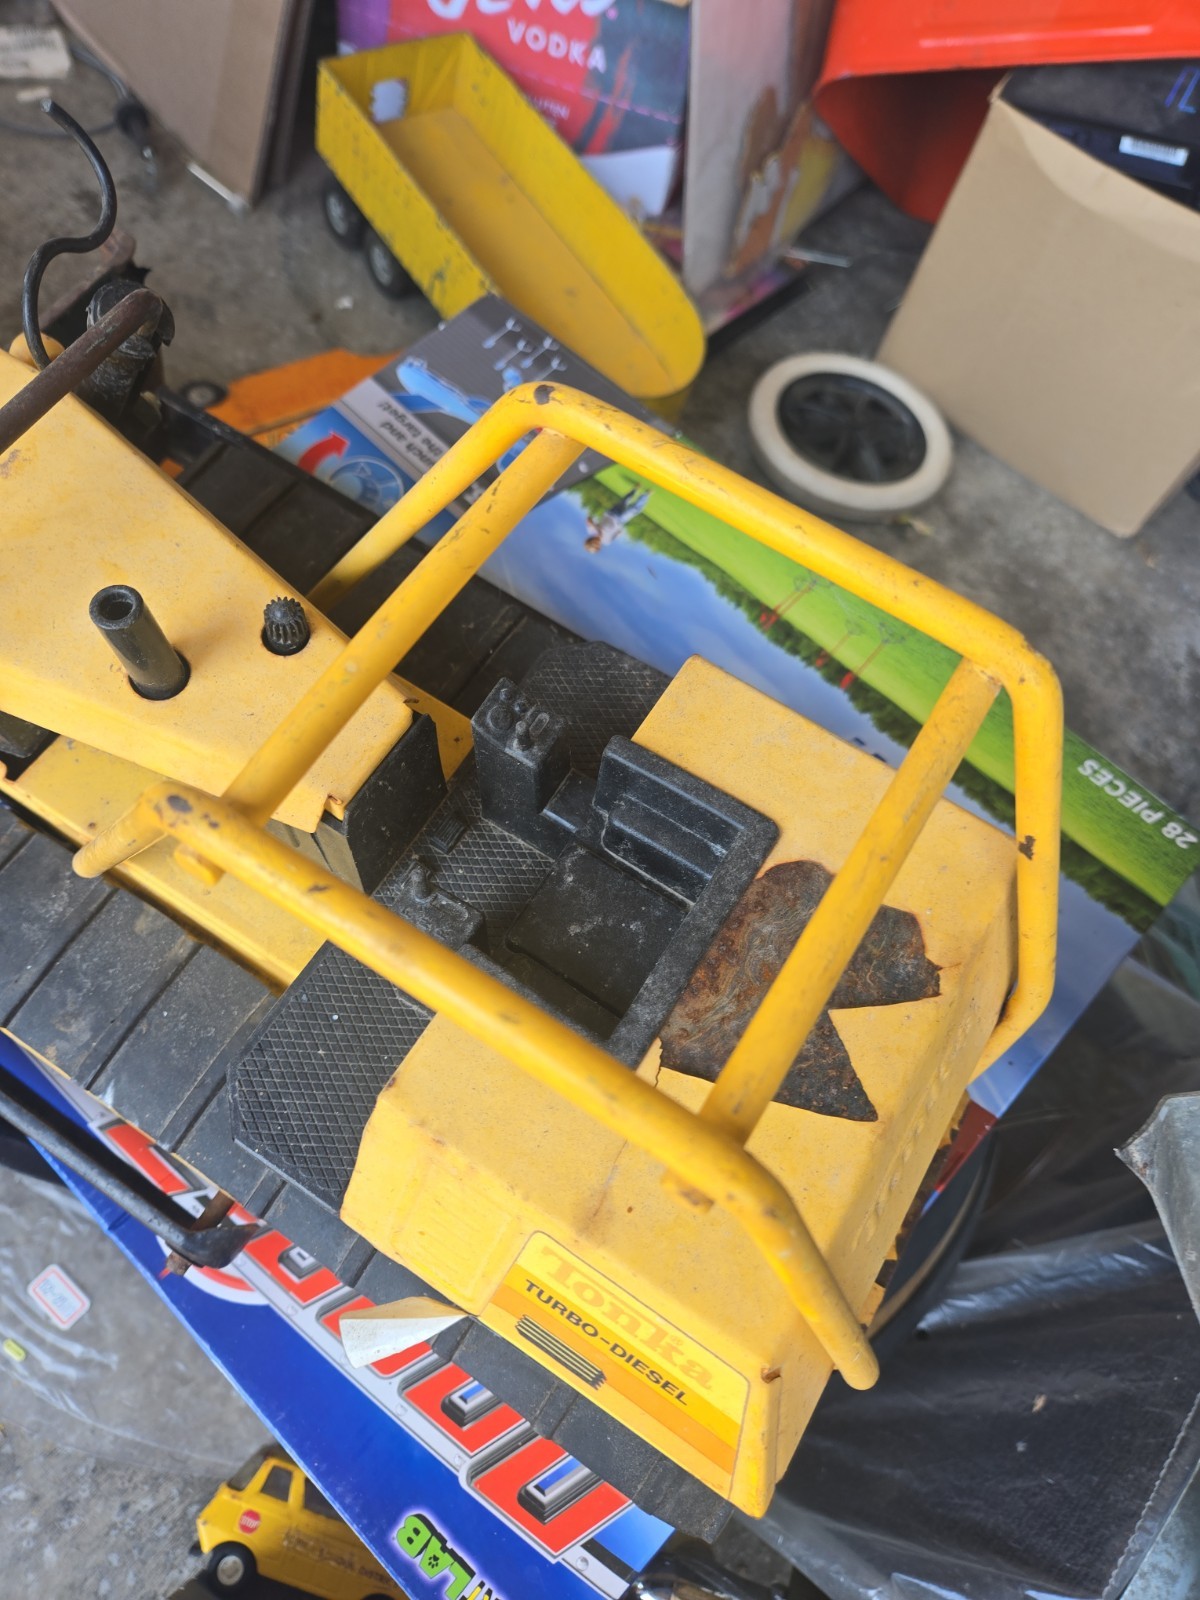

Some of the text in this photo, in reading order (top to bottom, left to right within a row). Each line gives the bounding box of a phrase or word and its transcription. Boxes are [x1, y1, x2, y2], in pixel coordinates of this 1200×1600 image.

[507, 16, 607, 74] VODKA
[1077, 758, 1199, 849] 28 PIECES
[525, 1278, 688, 1406] TURBO-DIESEL
[539, 1245, 715, 1391] Tonka
